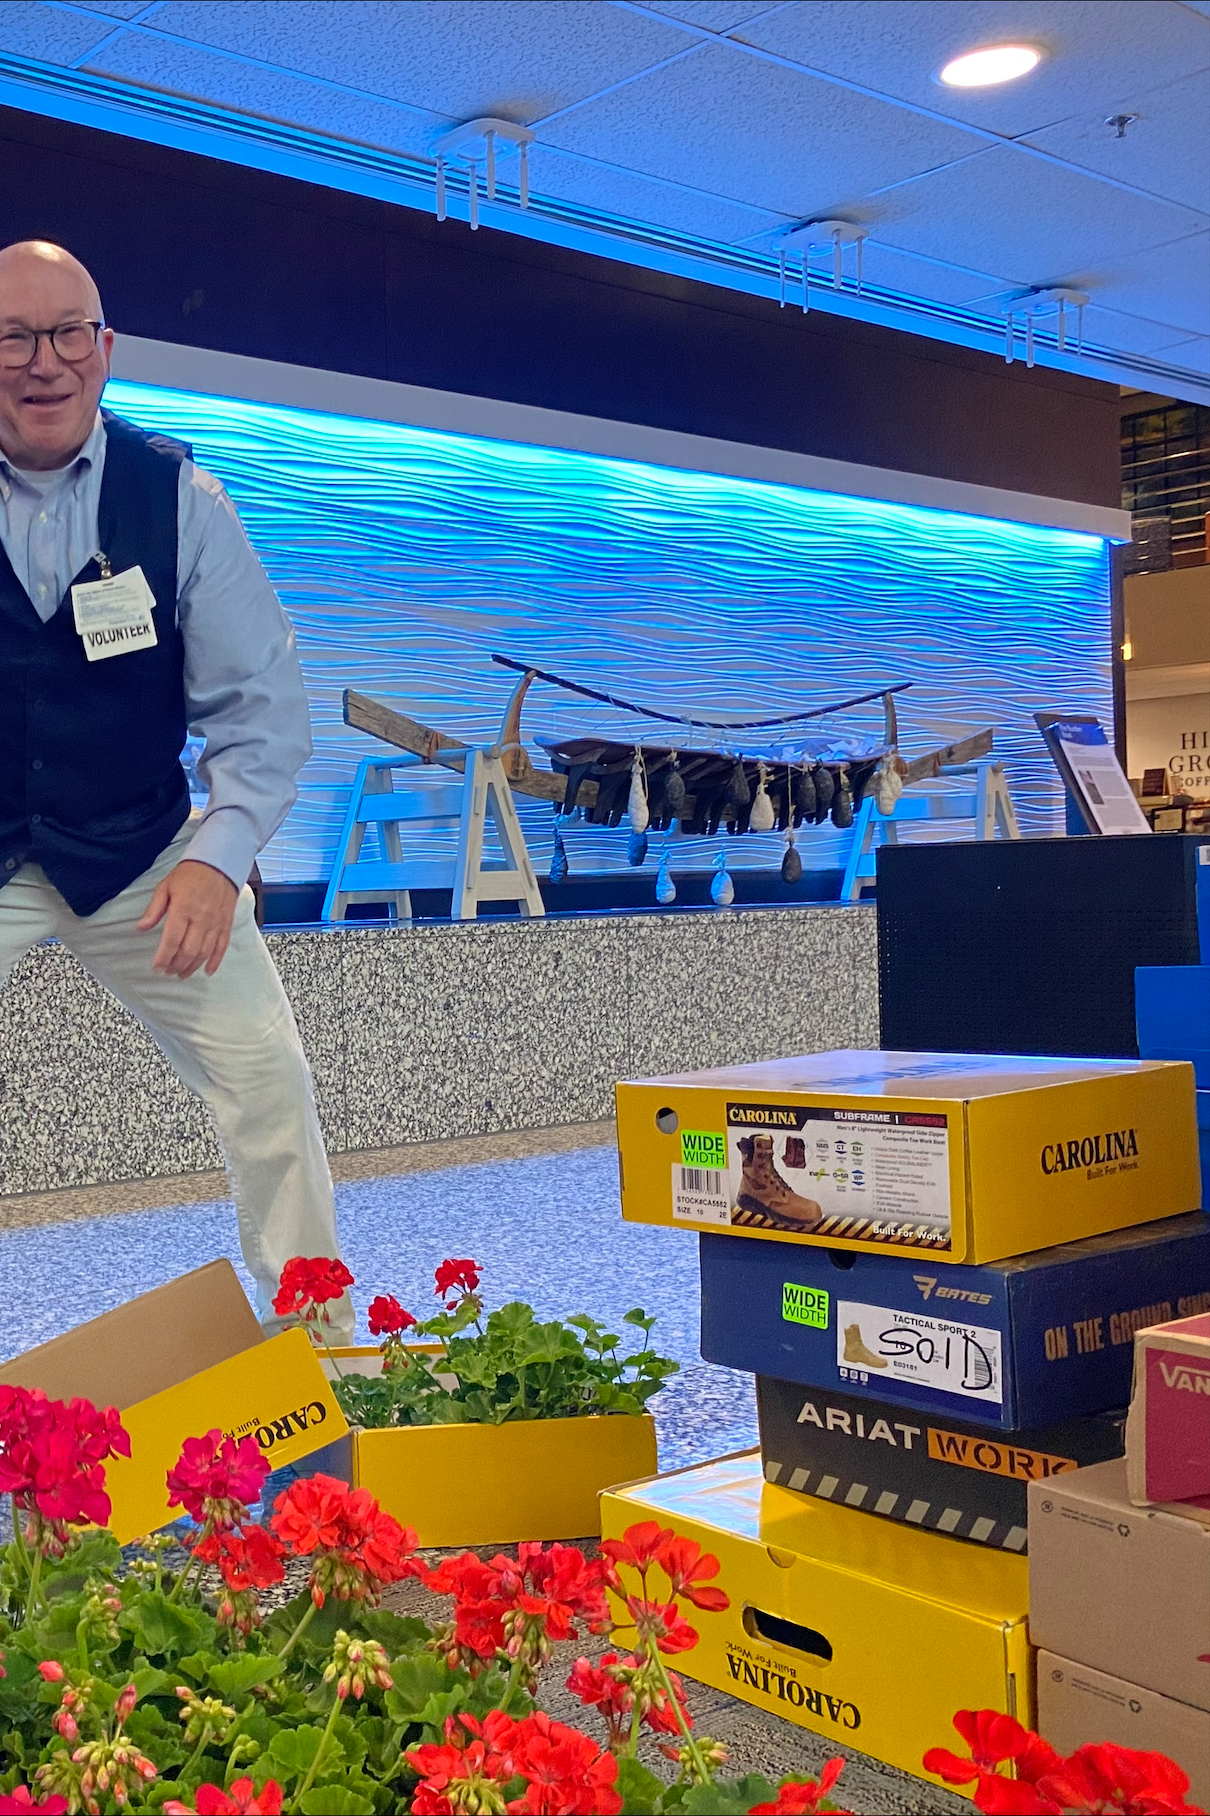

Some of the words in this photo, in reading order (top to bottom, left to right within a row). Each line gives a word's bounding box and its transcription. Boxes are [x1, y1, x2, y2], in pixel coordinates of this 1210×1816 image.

[730, 1107, 797, 1125] CAROLINA
[834, 1111, 890, 1122] SUBFRAME
[682, 1134, 724, 1152] WIDE
[1041, 1128, 1139, 1175] CAROLINA
[683, 1150, 725, 1165] WIDTH
[677, 1206, 691, 1215] SIZE
[872, 1226, 895, 1235] Built
[898, 1228, 913, 1237] For
[917, 1231, 946, 1241] Work.
[784, 1287, 826, 1311] WIDE
[935, 1286, 993, 1305] BATES
[784, 1304, 826, 1325] WIDTH
[893, 1314, 936, 1331] TACTICAL
[938, 1323, 968, 1336] SPORT
[970, 1330, 976, 1338] 2
[1044, 1326, 1069, 1361] ON
[1073, 1317, 1105, 1354] THE
[796, 1402, 921, 1449] ARIAT
[936, 1433, 1068, 1479] WORK
[755, 1654, 771, 1668] For
[773, 1661, 796, 1678] Built
[726, 1653, 862, 1730] CAROLINA
